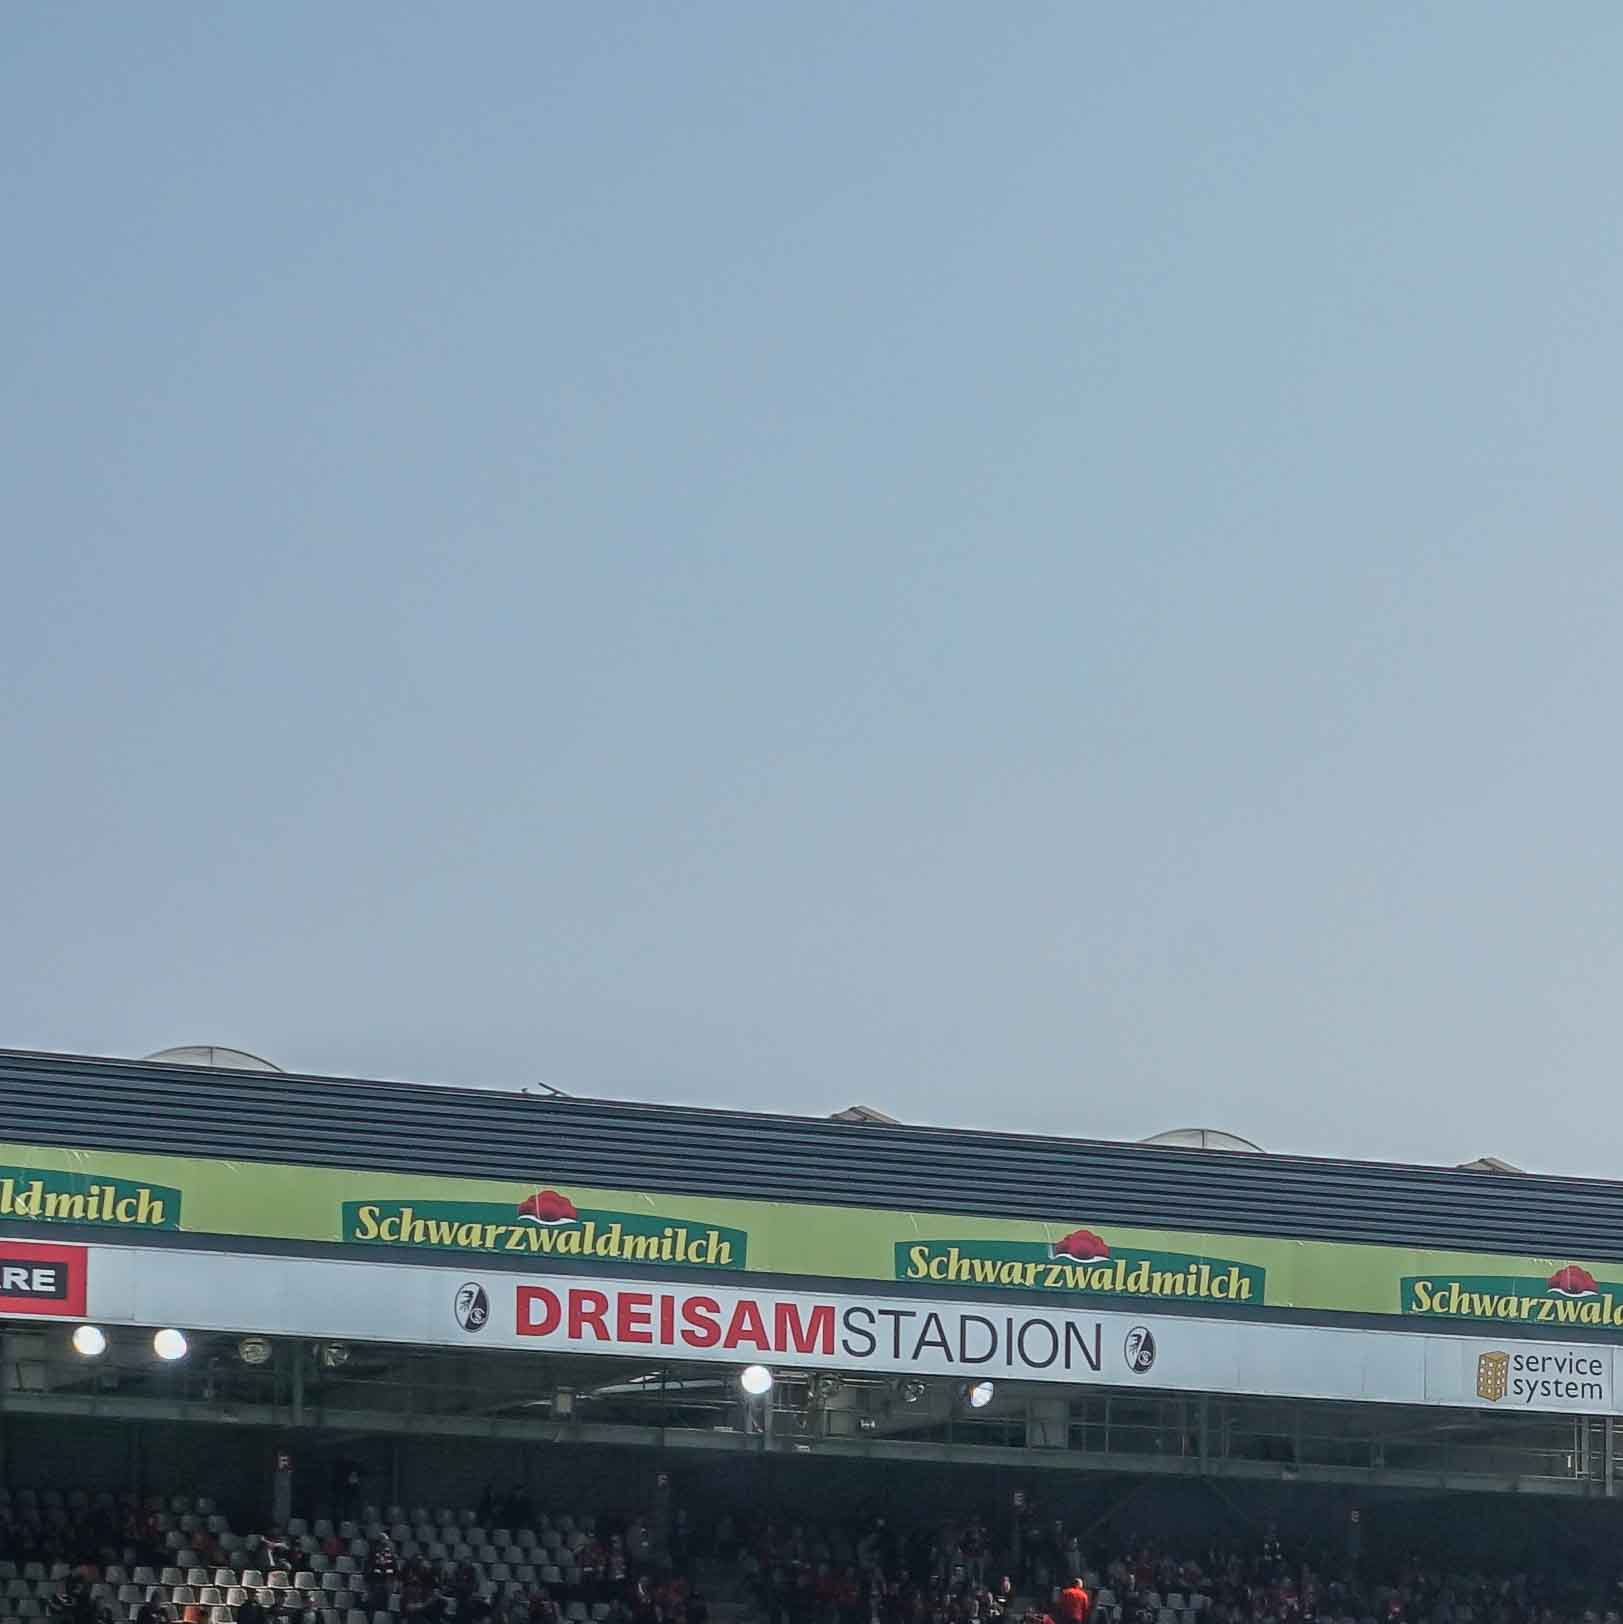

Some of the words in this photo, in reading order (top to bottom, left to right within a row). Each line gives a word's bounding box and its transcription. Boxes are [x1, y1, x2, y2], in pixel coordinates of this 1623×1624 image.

[355, 1204, 734, 1267] Schwarzwaldmilch
[0, 1266, 56, 1292] RE
[906, 1246, 1253, 1303] Schwarzwaldmilch
[1513, 1351, 1603, 1377] service
[1513, 1374, 1603, 1402] system
